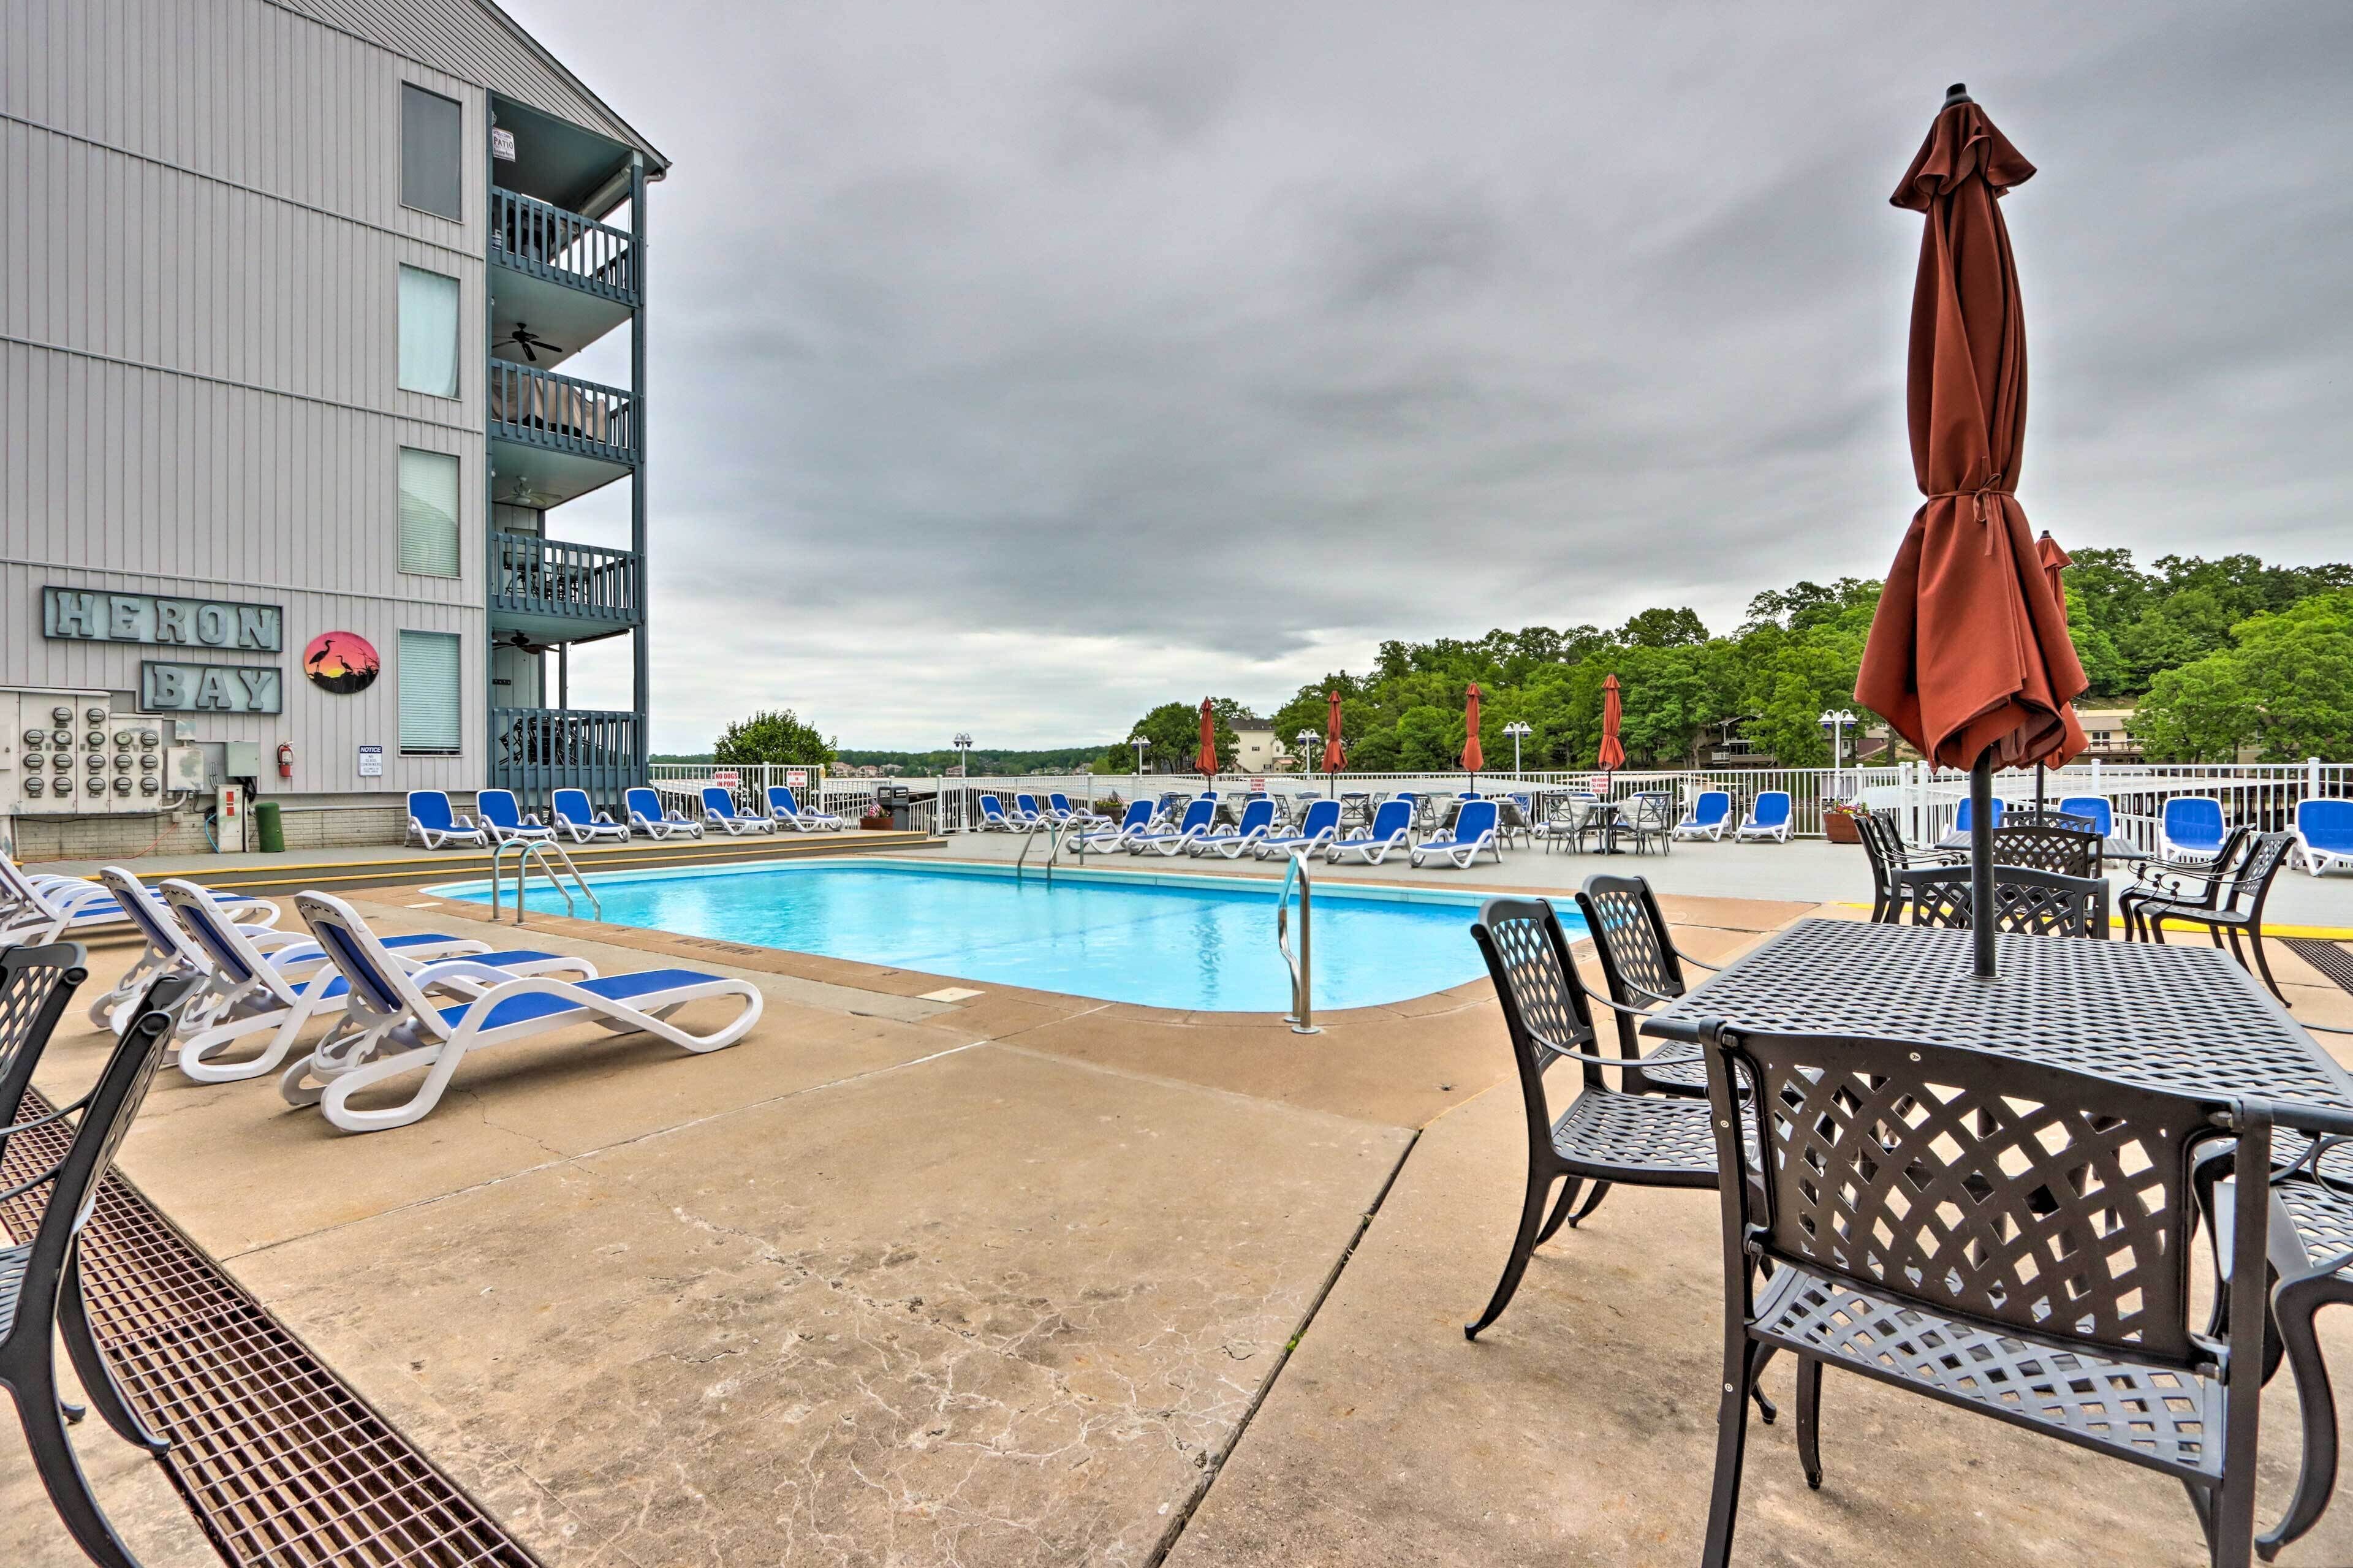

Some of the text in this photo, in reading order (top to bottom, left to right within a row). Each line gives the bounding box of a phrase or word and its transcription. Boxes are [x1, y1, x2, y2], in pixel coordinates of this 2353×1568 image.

[494, 137, 513, 149] PATIO
[56, 592, 273, 648] HERON
[153, 665, 273, 710] BAY
[697, 942, 762, 955] DIVING
